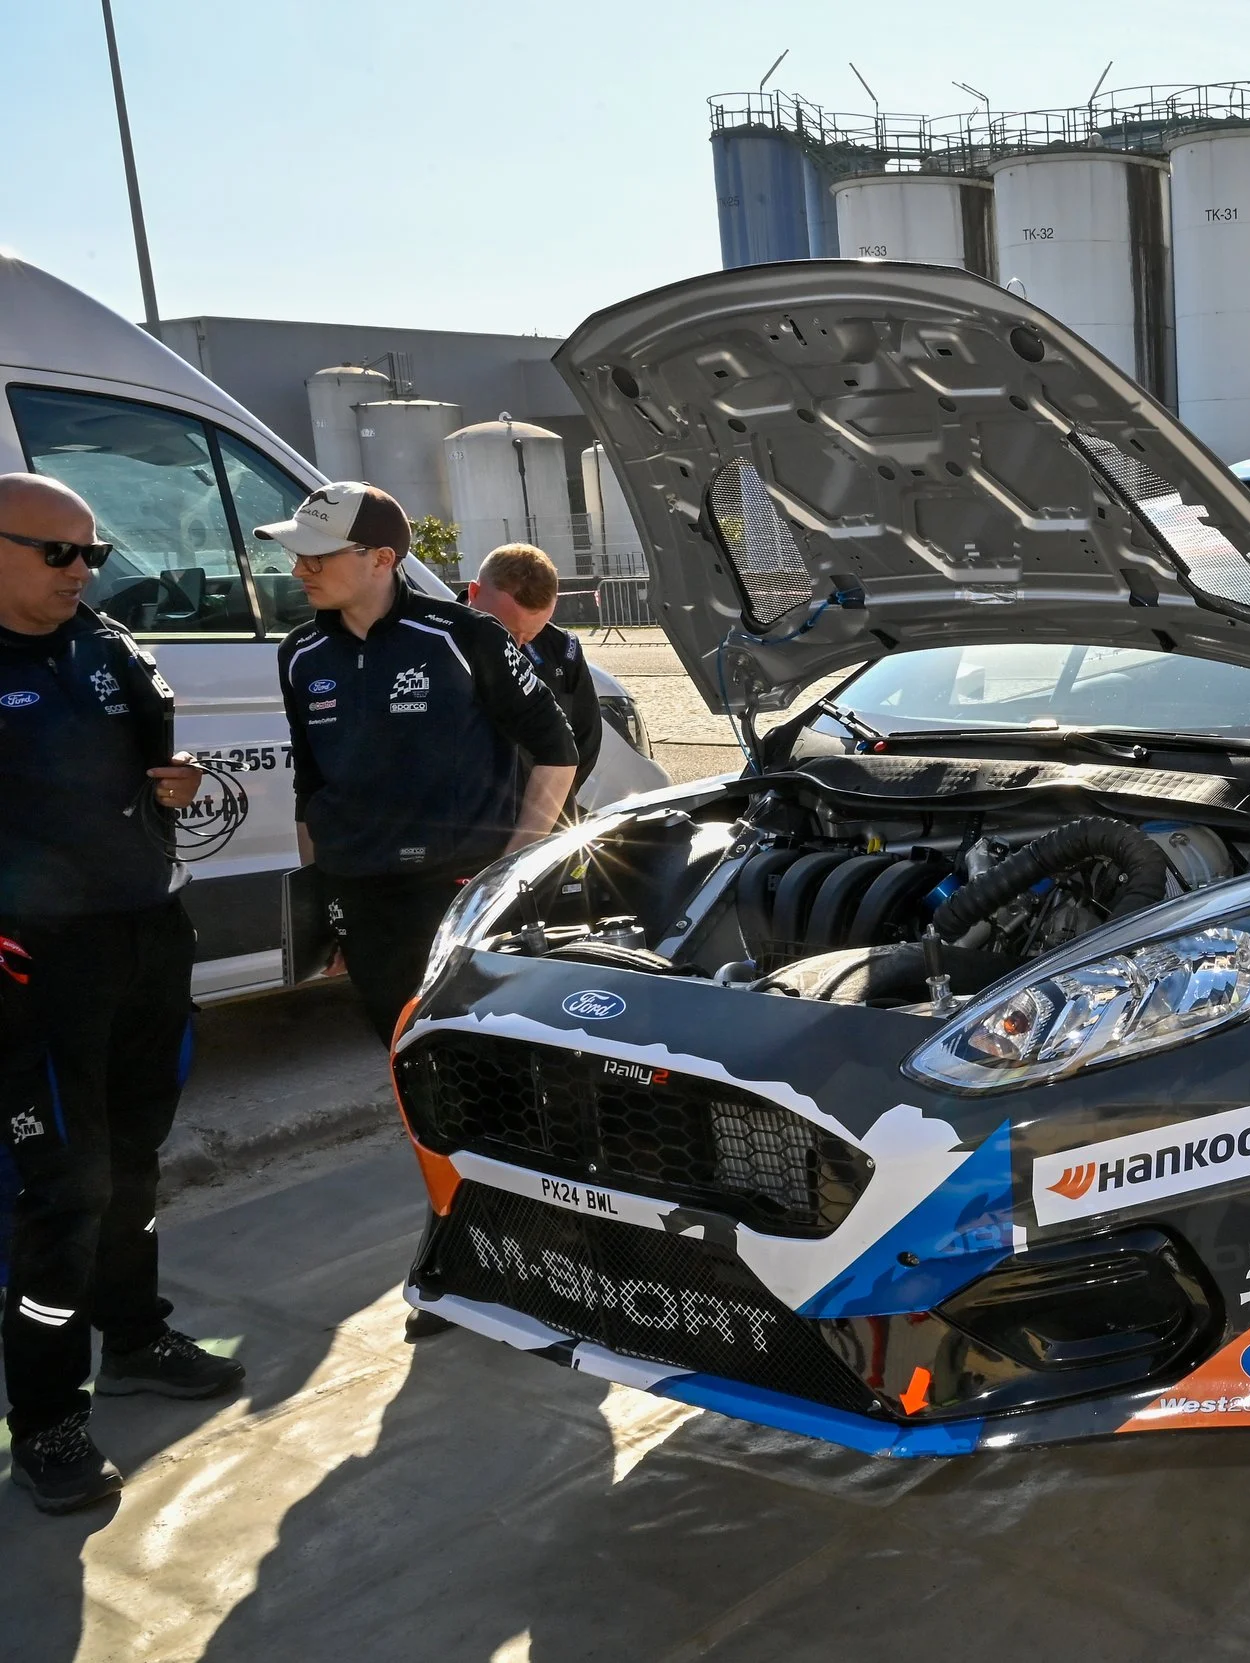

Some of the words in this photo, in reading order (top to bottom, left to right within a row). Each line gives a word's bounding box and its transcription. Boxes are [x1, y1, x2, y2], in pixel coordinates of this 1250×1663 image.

[1205, 207, 1239, 221] TK-31
[1022, 227, 1054, 240] TK-32
[859, 245, 888, 258] TK-33
[7, 693, 33, 706] Ford
[391, 702, 427, 712] sparco
[229, 747, 276, 773] 255
[568, 992, 617, 1018] Ford
[603, 1060, 671, 1086] Rally2
[541, 1177, 580, 1206] PX24
[585, 1189, 619, 1216] BWL
[467, 1222, 778, 1353] M-SPORT
